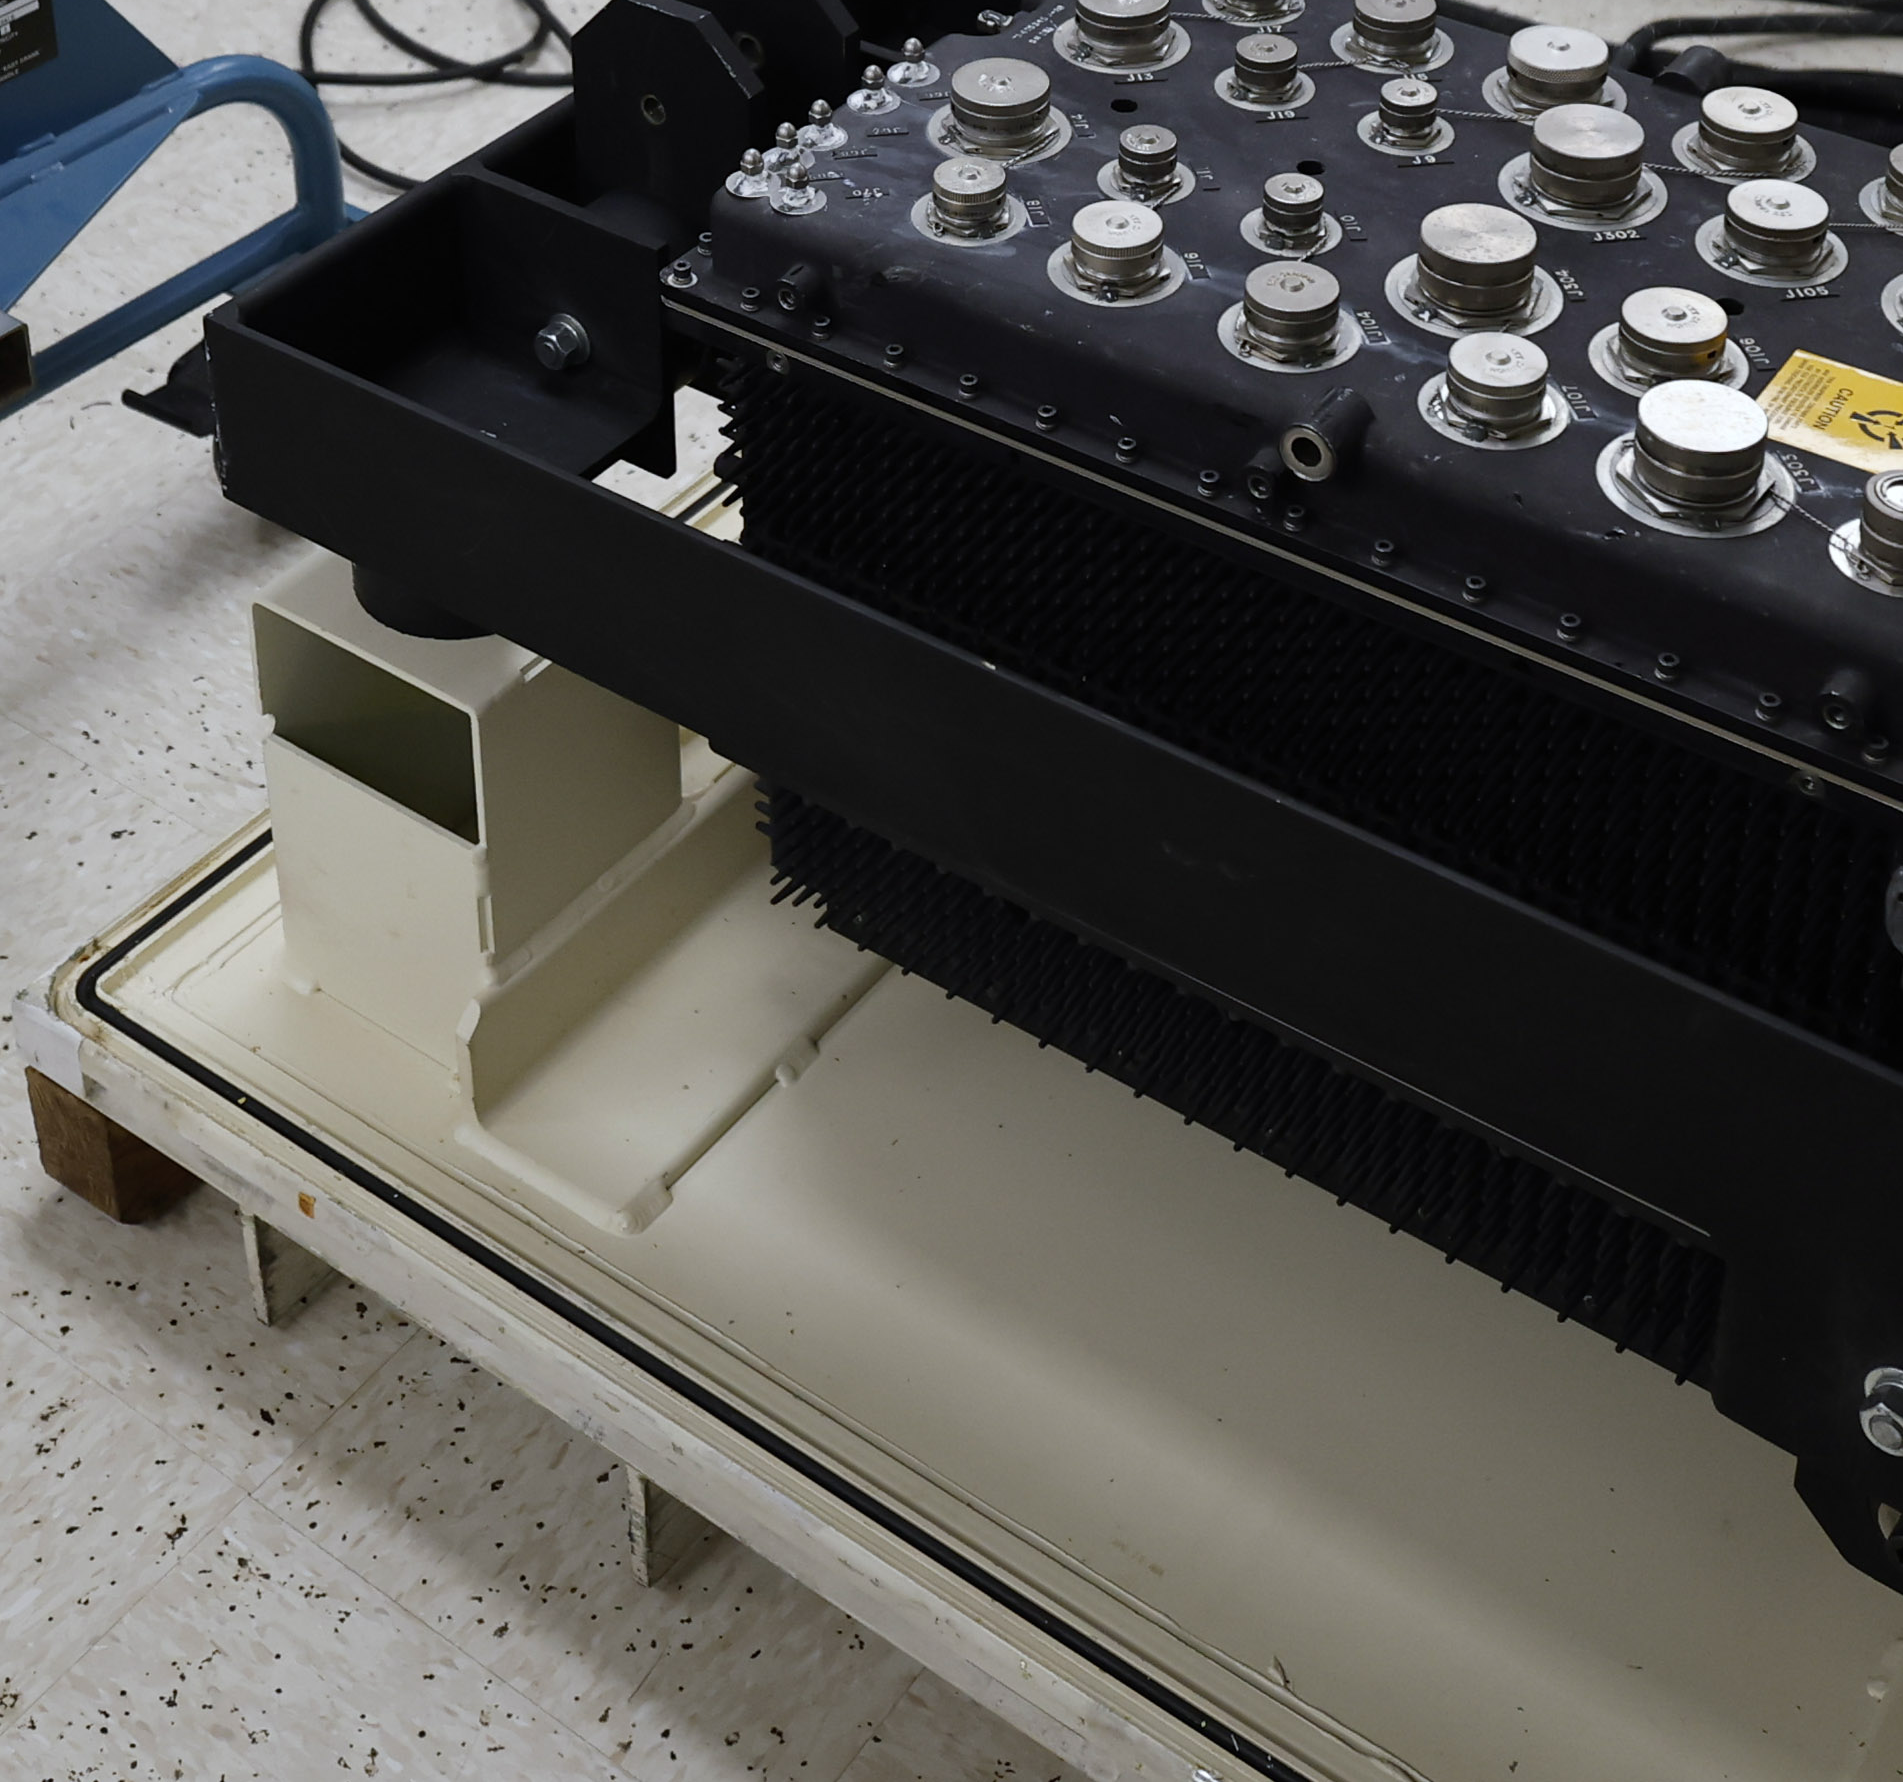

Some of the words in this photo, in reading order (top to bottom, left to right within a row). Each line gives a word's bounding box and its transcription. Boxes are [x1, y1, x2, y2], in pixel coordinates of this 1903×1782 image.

[1126, 73, 1155, 84] J13
[1411, 154, 1438, 166] J9
[1026, 198, 1046, 217] J18
[1339, 213, 1362, 232] J10
[1592, 229, 1642, 243] J302
[1554, 268, 1585, 299] J304
[1784, 285, 1831, 300] J105
[1356, 308, 1384, 340] J104
[1739, 335, 1771, 365] J106
[1560, 384, 1591, 413] J107
[1812, 387, 1855, 431] CAUTION
[1781, 451, 1816, 492] J303
